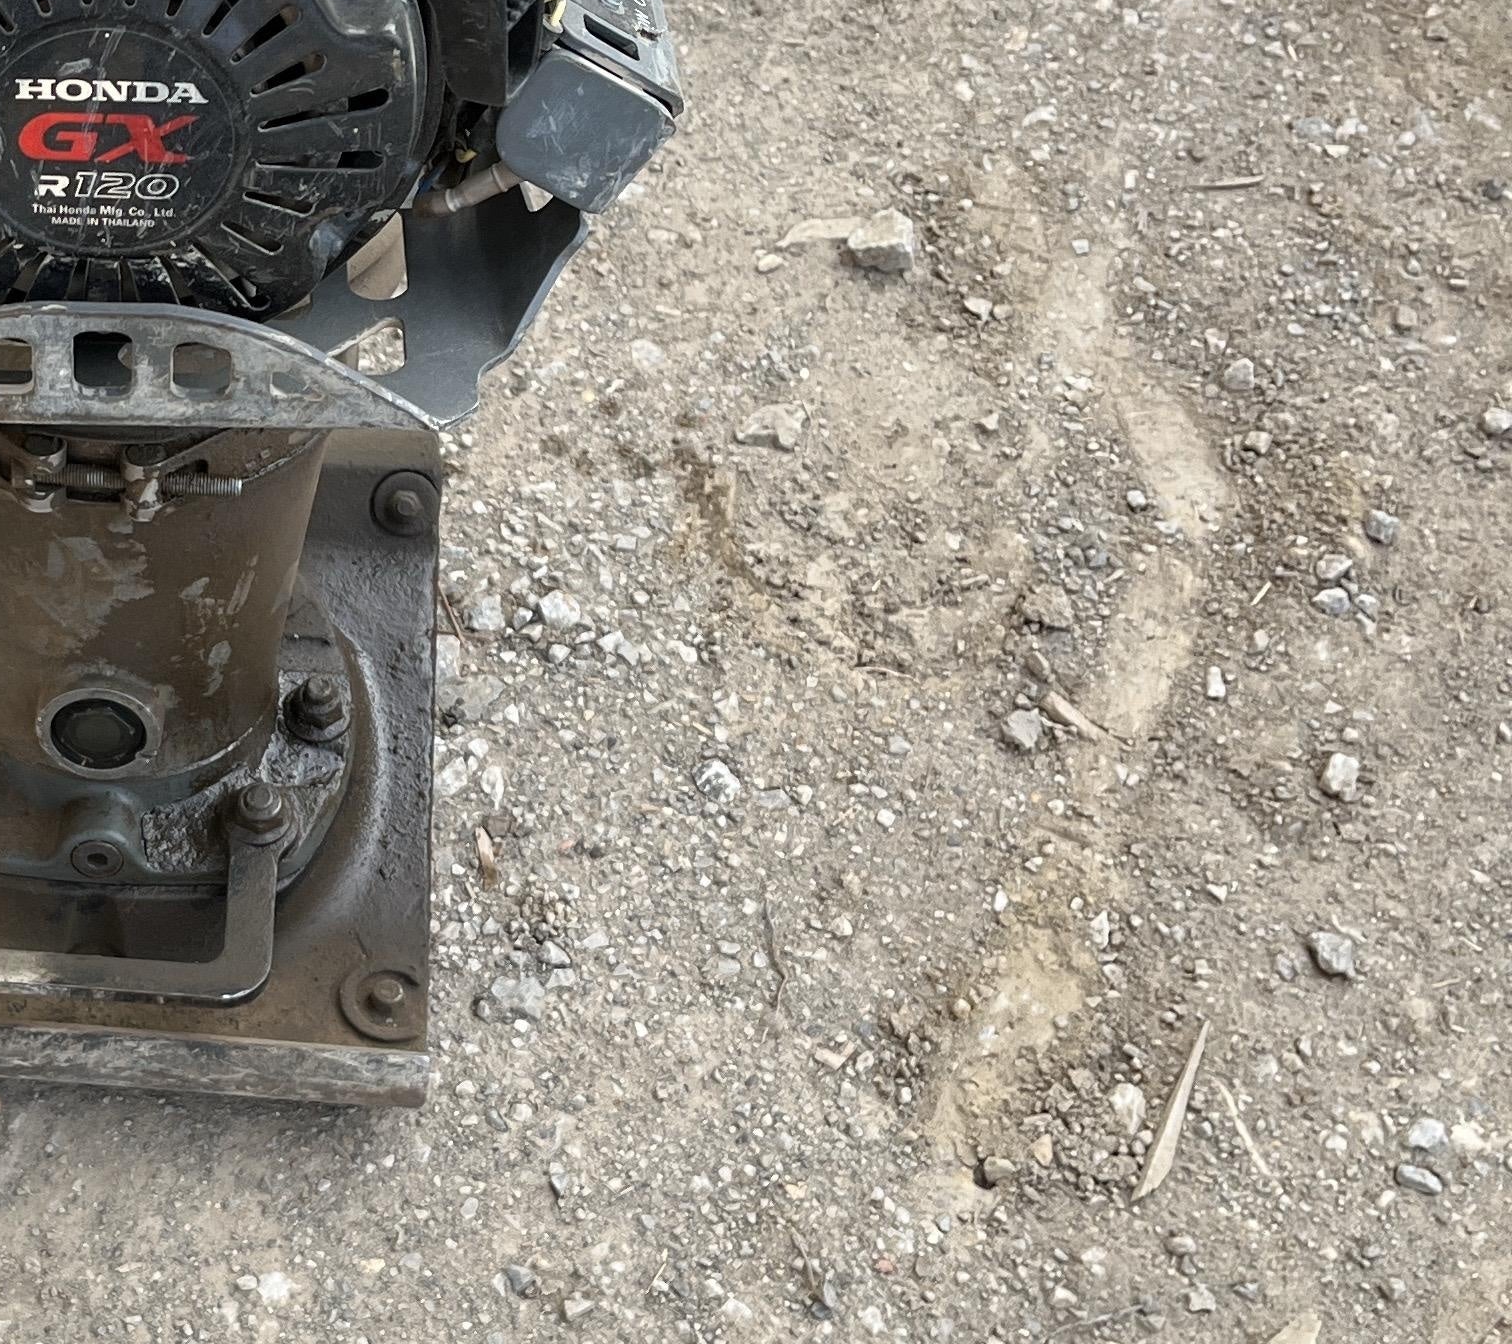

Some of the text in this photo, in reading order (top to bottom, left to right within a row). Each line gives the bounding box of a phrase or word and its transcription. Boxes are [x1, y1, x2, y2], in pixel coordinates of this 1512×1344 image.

[15, 79, 209, 104] HONDA
[18, 112, 199, 164] GX
[32, 204, 56, 214] Thai
[59, 204, 97, 215] Honda
[52, 216, 155, 228] MADE IN THAILAND
